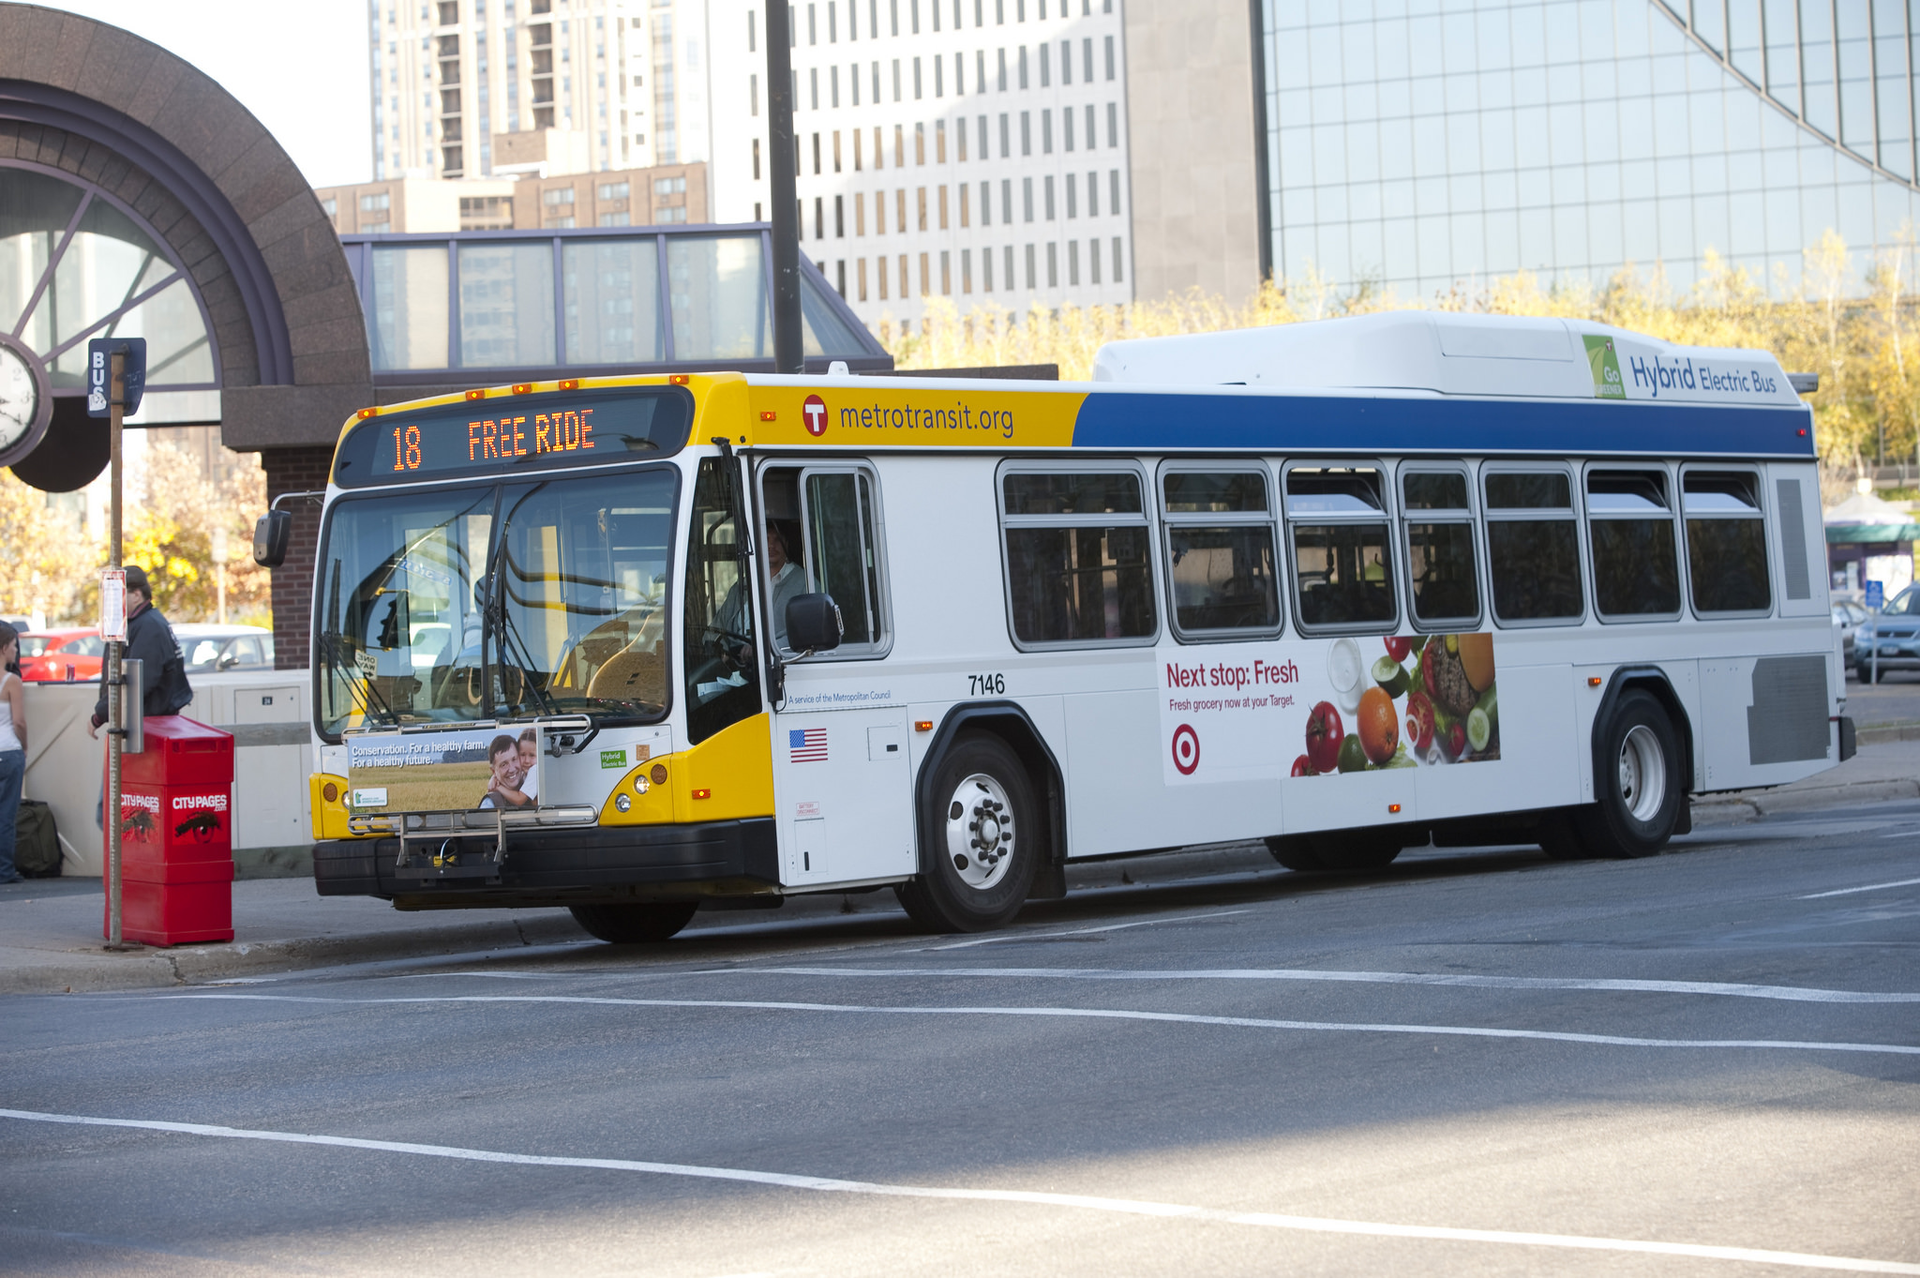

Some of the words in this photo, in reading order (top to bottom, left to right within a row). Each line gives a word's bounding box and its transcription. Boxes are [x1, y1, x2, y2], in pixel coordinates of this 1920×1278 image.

[1604, 366, 1620, 382] Go
[1630, 355, 1696, 398] Hybrid
[1699, 367, 1750, 392] Electric
[1751, 370, 1777, 393] Bus
[840, 402, 1014, 438] metrotransit.org
[393, 425, 421, 471] 18
[469, 416, 527, 461] FREE
[535, 409, 595, 454] RIDE
[1166, 662, 1207, 688] Next
[1210, 662, 1250, 691] stop:
[1254, 658, 1299, 684] Fresh
[968, 673, 1005, 696] 7146
[788, 695, 794, 704] A
[795, 694, 814, 704] service
[815, 693, 821, 703] of
[822, 693, 832, 703] the
[833, 691, 869, 704] Metropolitan
[870, 690, 891, 700] Council
[1169, 698, 1192, 711] Fresh
[1193, 699, 1223, 713] grocery
[1224, 699, 1241, 709] now
[1242, 696, 1250, 708] at
[1251, 697, 1268, 710] your
[1269, 694, 1295, 709] Target.
[352, 743, 408, 756] Conservation.
[409, 742, 423, 754] For
[424, 744, 430, 752] a
[431, 740, 463, 753] healthy
[463, 740, 486, 750] farm.
[352, 757, 367, 768] For
[367, 759, 373, 767] a
[374, 755, 404, 768] healthy
[405, 755, 434, 765] future.
[601, 752, 621, 762] Hybrid
[136, 796, 160, 809] PAGES
[172, 796, 195, 810] CITY
[196, 794, 227, 808] PAGES
